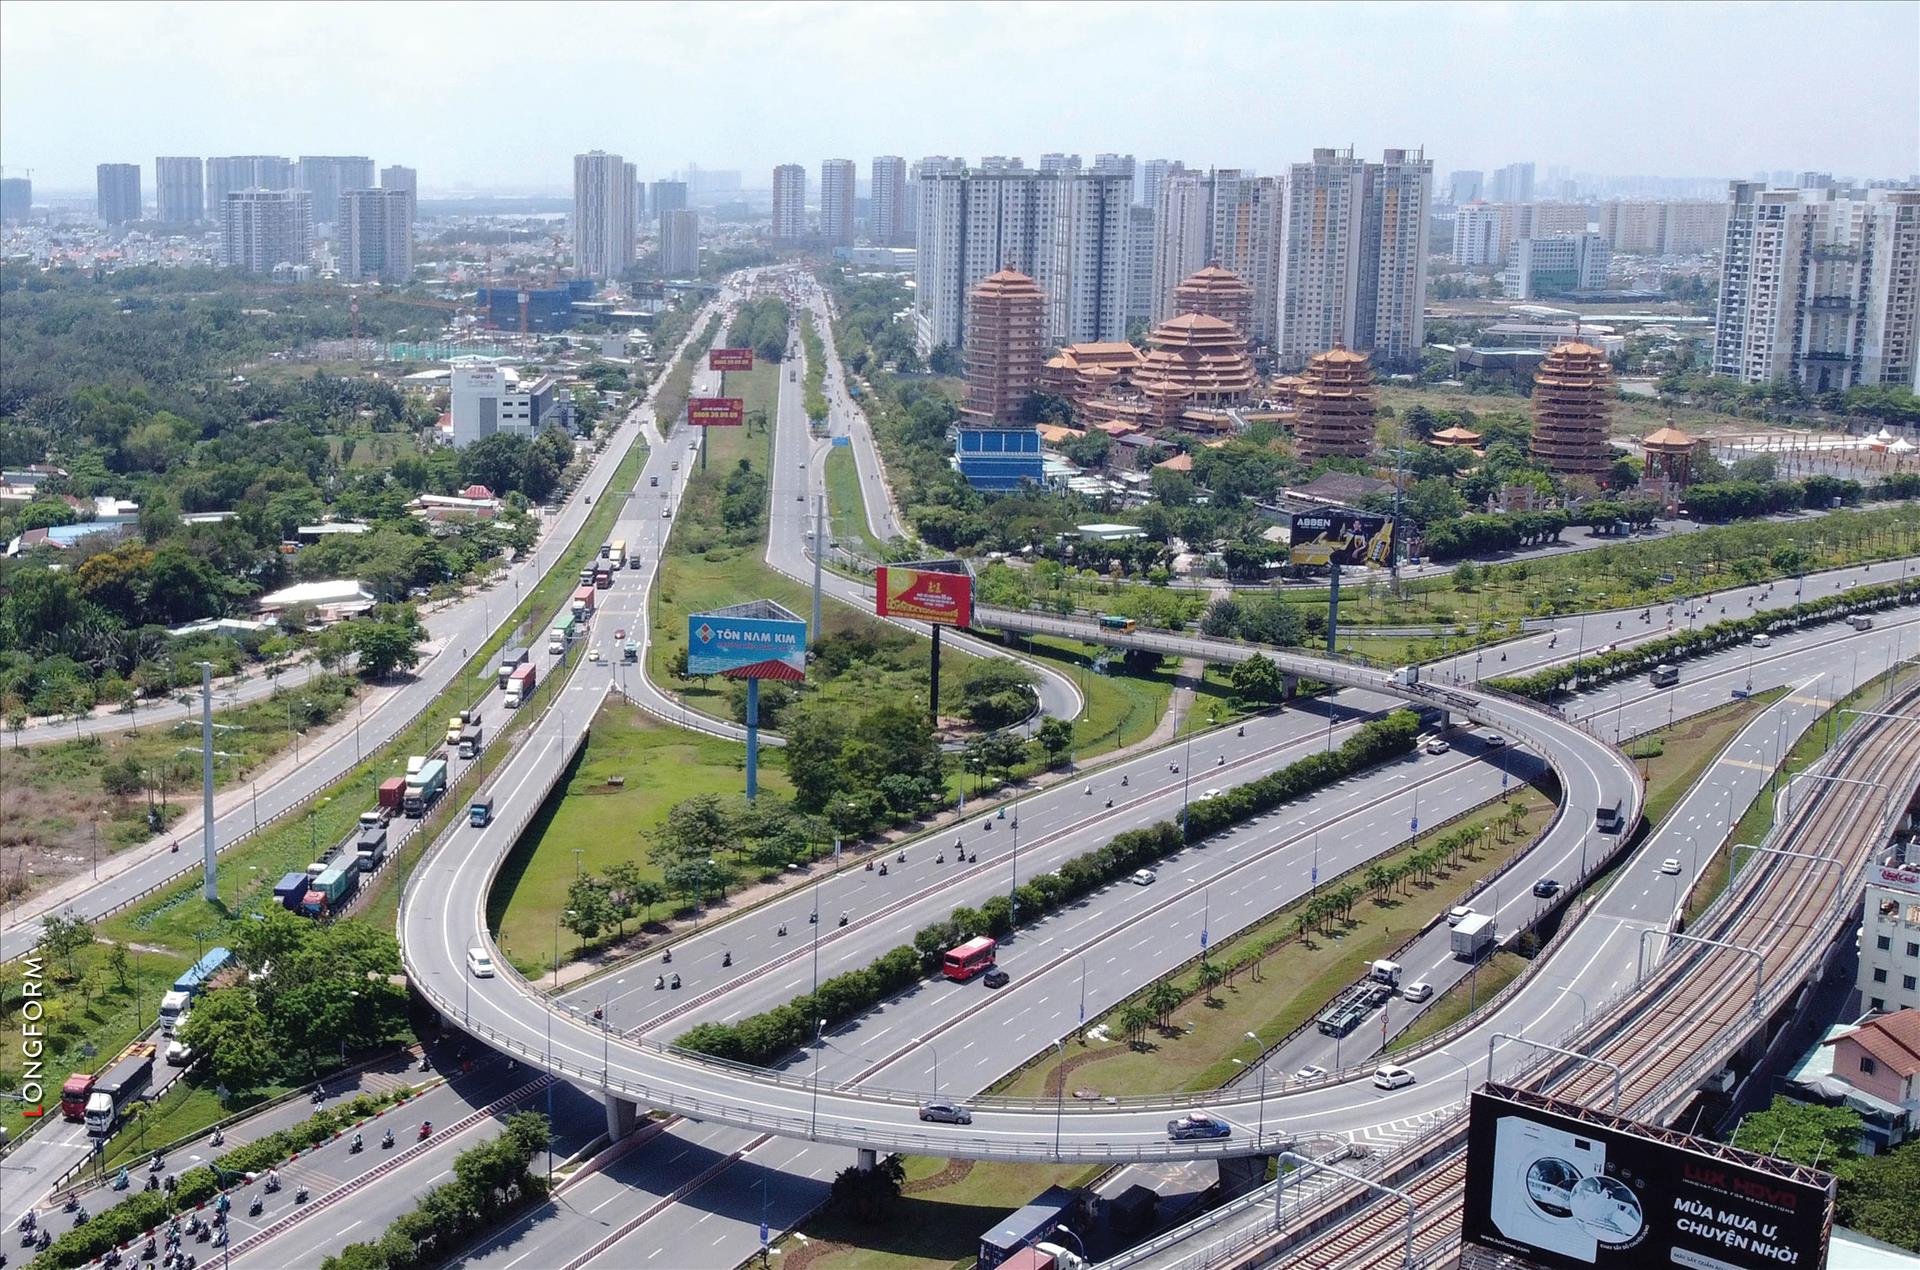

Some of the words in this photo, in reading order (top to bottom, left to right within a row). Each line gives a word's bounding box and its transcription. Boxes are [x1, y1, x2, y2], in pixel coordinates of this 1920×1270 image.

[1296, 518, 1331, 527] ABBEN
[716, 628, 740, 641] TÔN
[743, 631, 771, 643] NAM
[774, 633, 796, 644] KIM
[1673, 1198, 1713, 1220] MÙA
[1717, 1210, 1758, 1234] MƯA
[1761, 1224, 1778, 1241] Ư,
[1676, 1218, 1748, 1249] CHUYỆN
